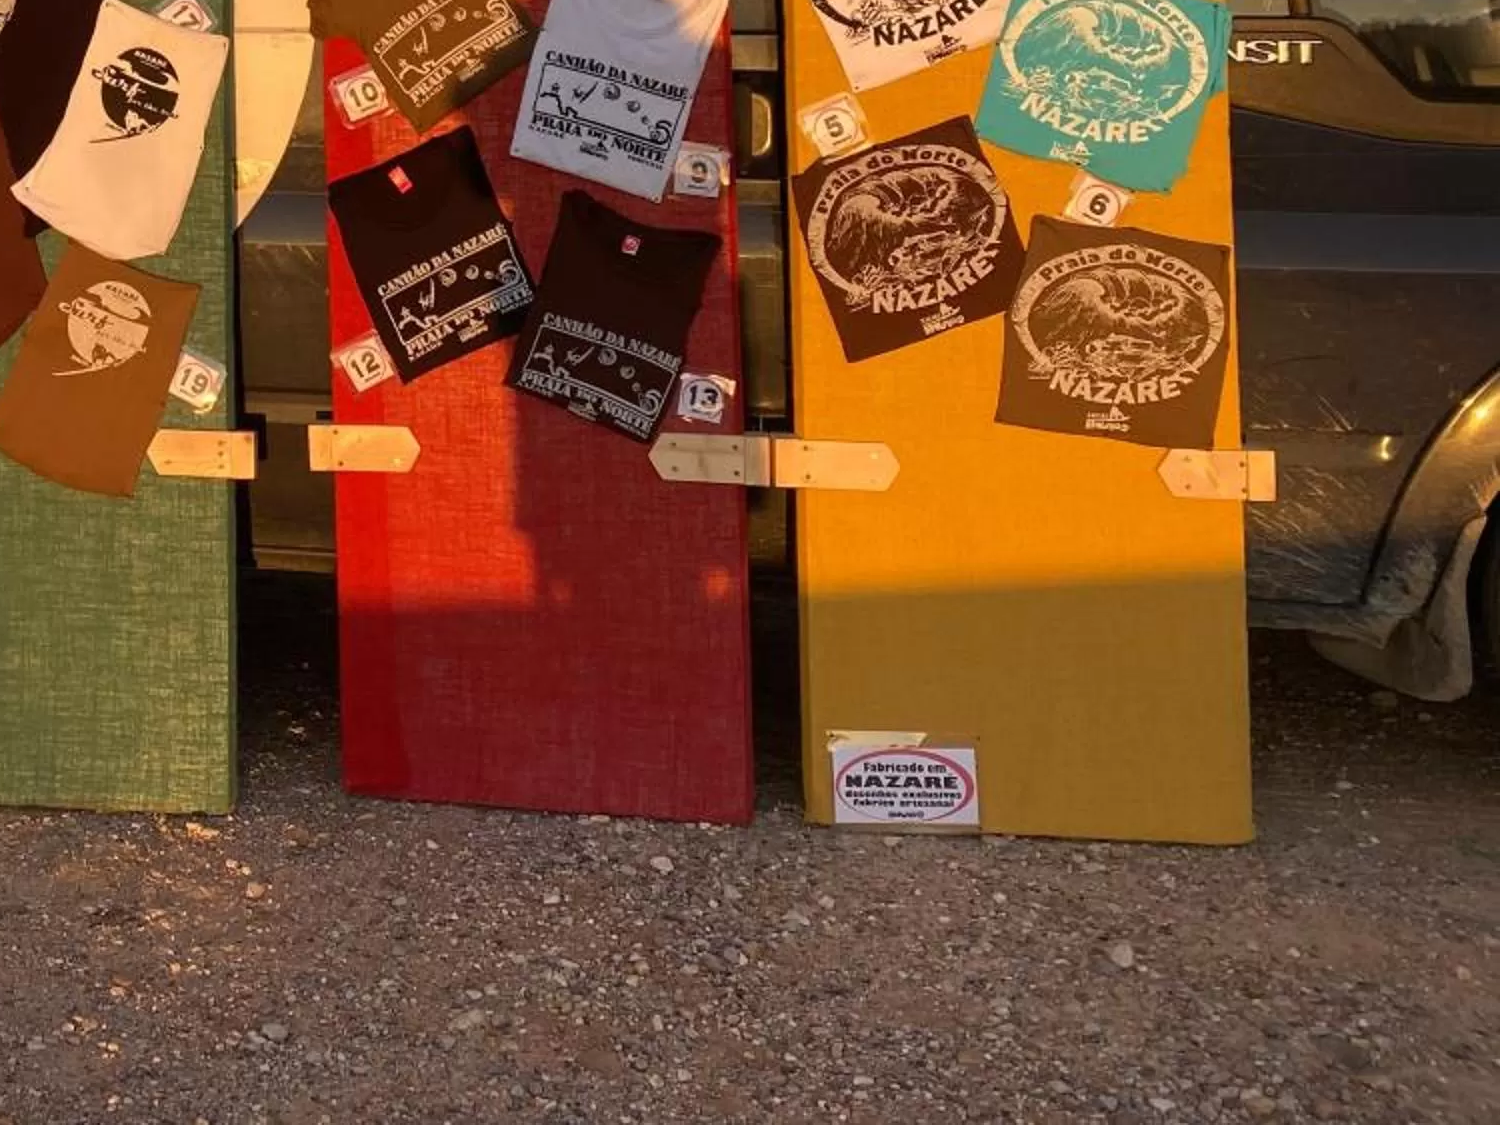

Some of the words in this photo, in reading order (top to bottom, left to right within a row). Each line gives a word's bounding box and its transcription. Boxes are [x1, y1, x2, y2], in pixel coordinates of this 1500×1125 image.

[545, 50, 605, 74] CANHÃO
[609, 65, 628, 81] DA
[349, 82, 378, 107] 10
[531, 112, 583, 138] PRAIA
[824, 115, 844, 138] 5
[818, 168, 861, 214] Praia
[867, 154, 894, 170] do
[901, 148, 967, 168] Norte
[1089, 193, 1110, 215] 6
[1039, 252, 1099, 281] Praia
[1108, 248, 1136, 262] do
[1146, 252, 1205, 293] Norte
[351, 351, 380, 378] 12
[180, 368, 208, 394] 19
[863, 762, 924, 773] Fabricado
[927, 764, 946, 773] em
